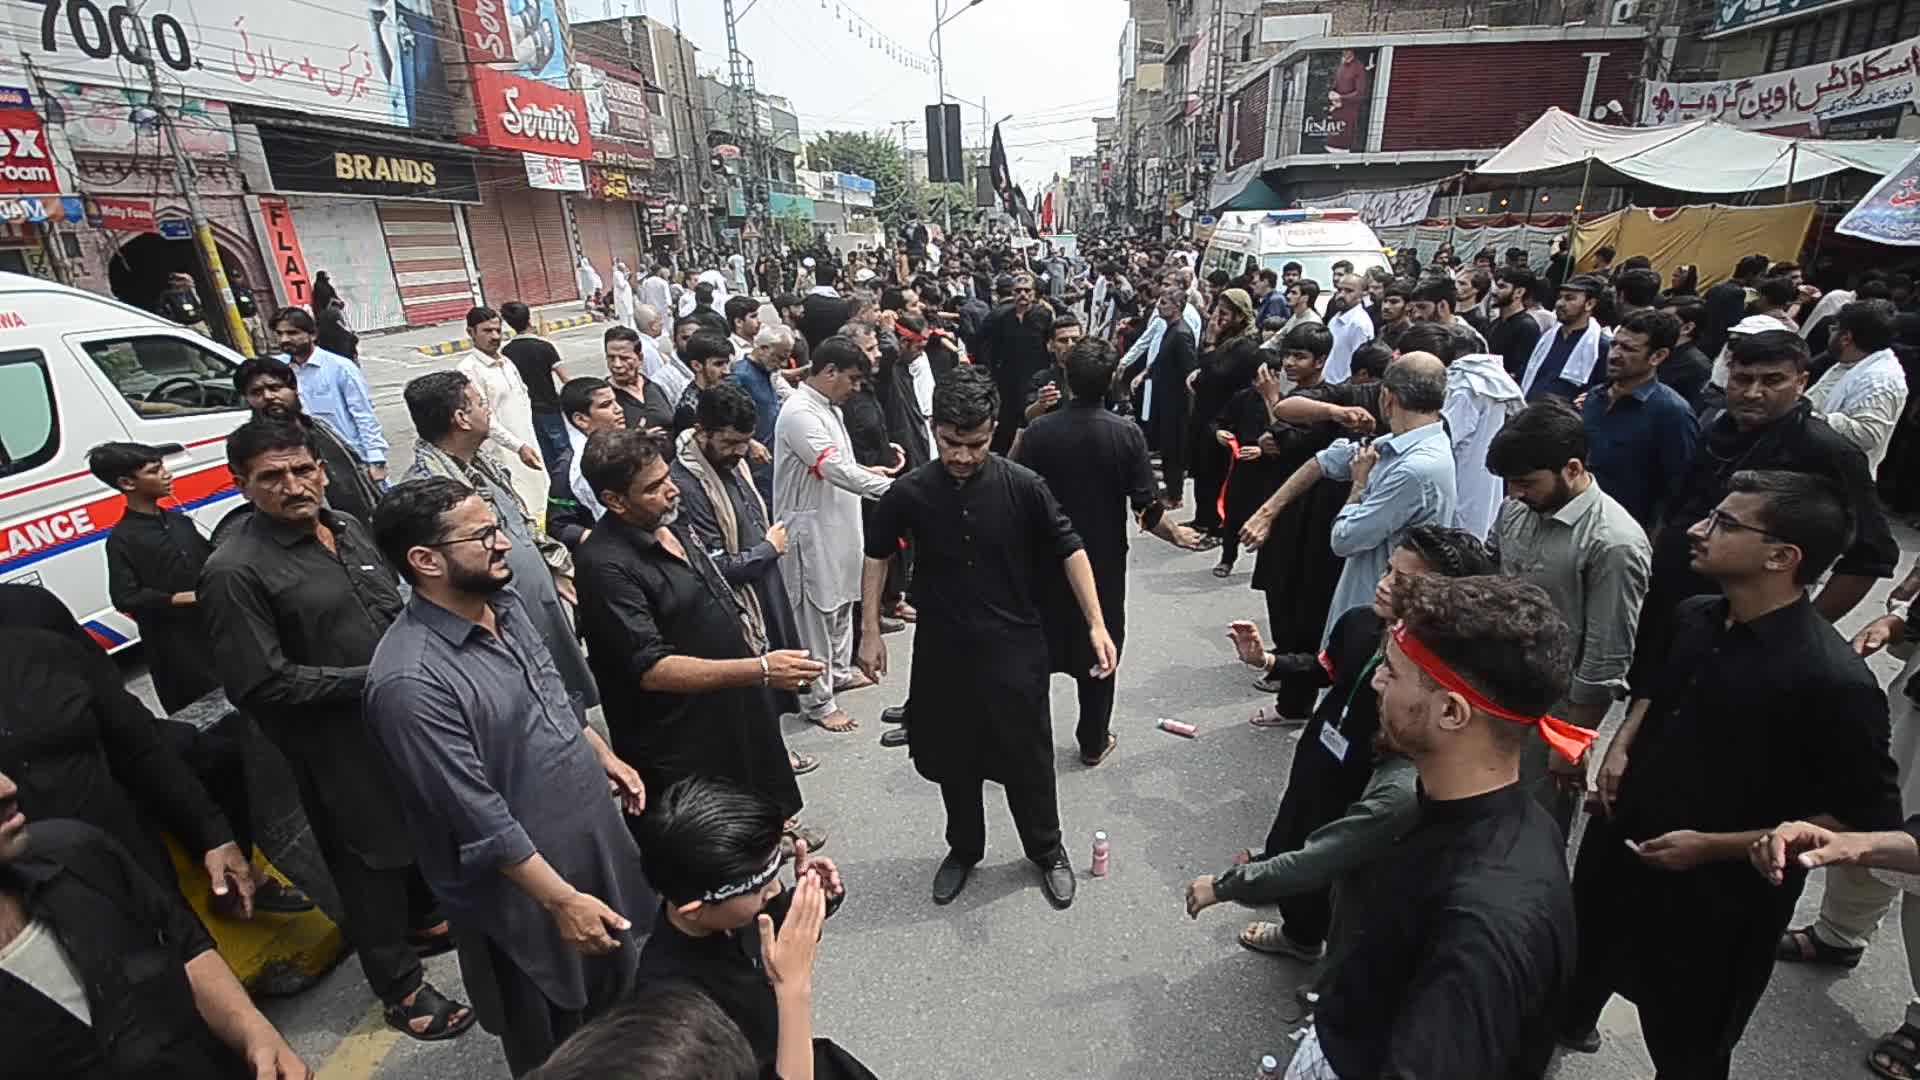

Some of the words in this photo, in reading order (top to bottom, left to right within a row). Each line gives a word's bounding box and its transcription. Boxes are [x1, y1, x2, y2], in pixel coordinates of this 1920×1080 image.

[0, 161, 51, 182] oam
[335, 152, 437, 186] BRANDS
[269, 207, 307, 300] FLAT
